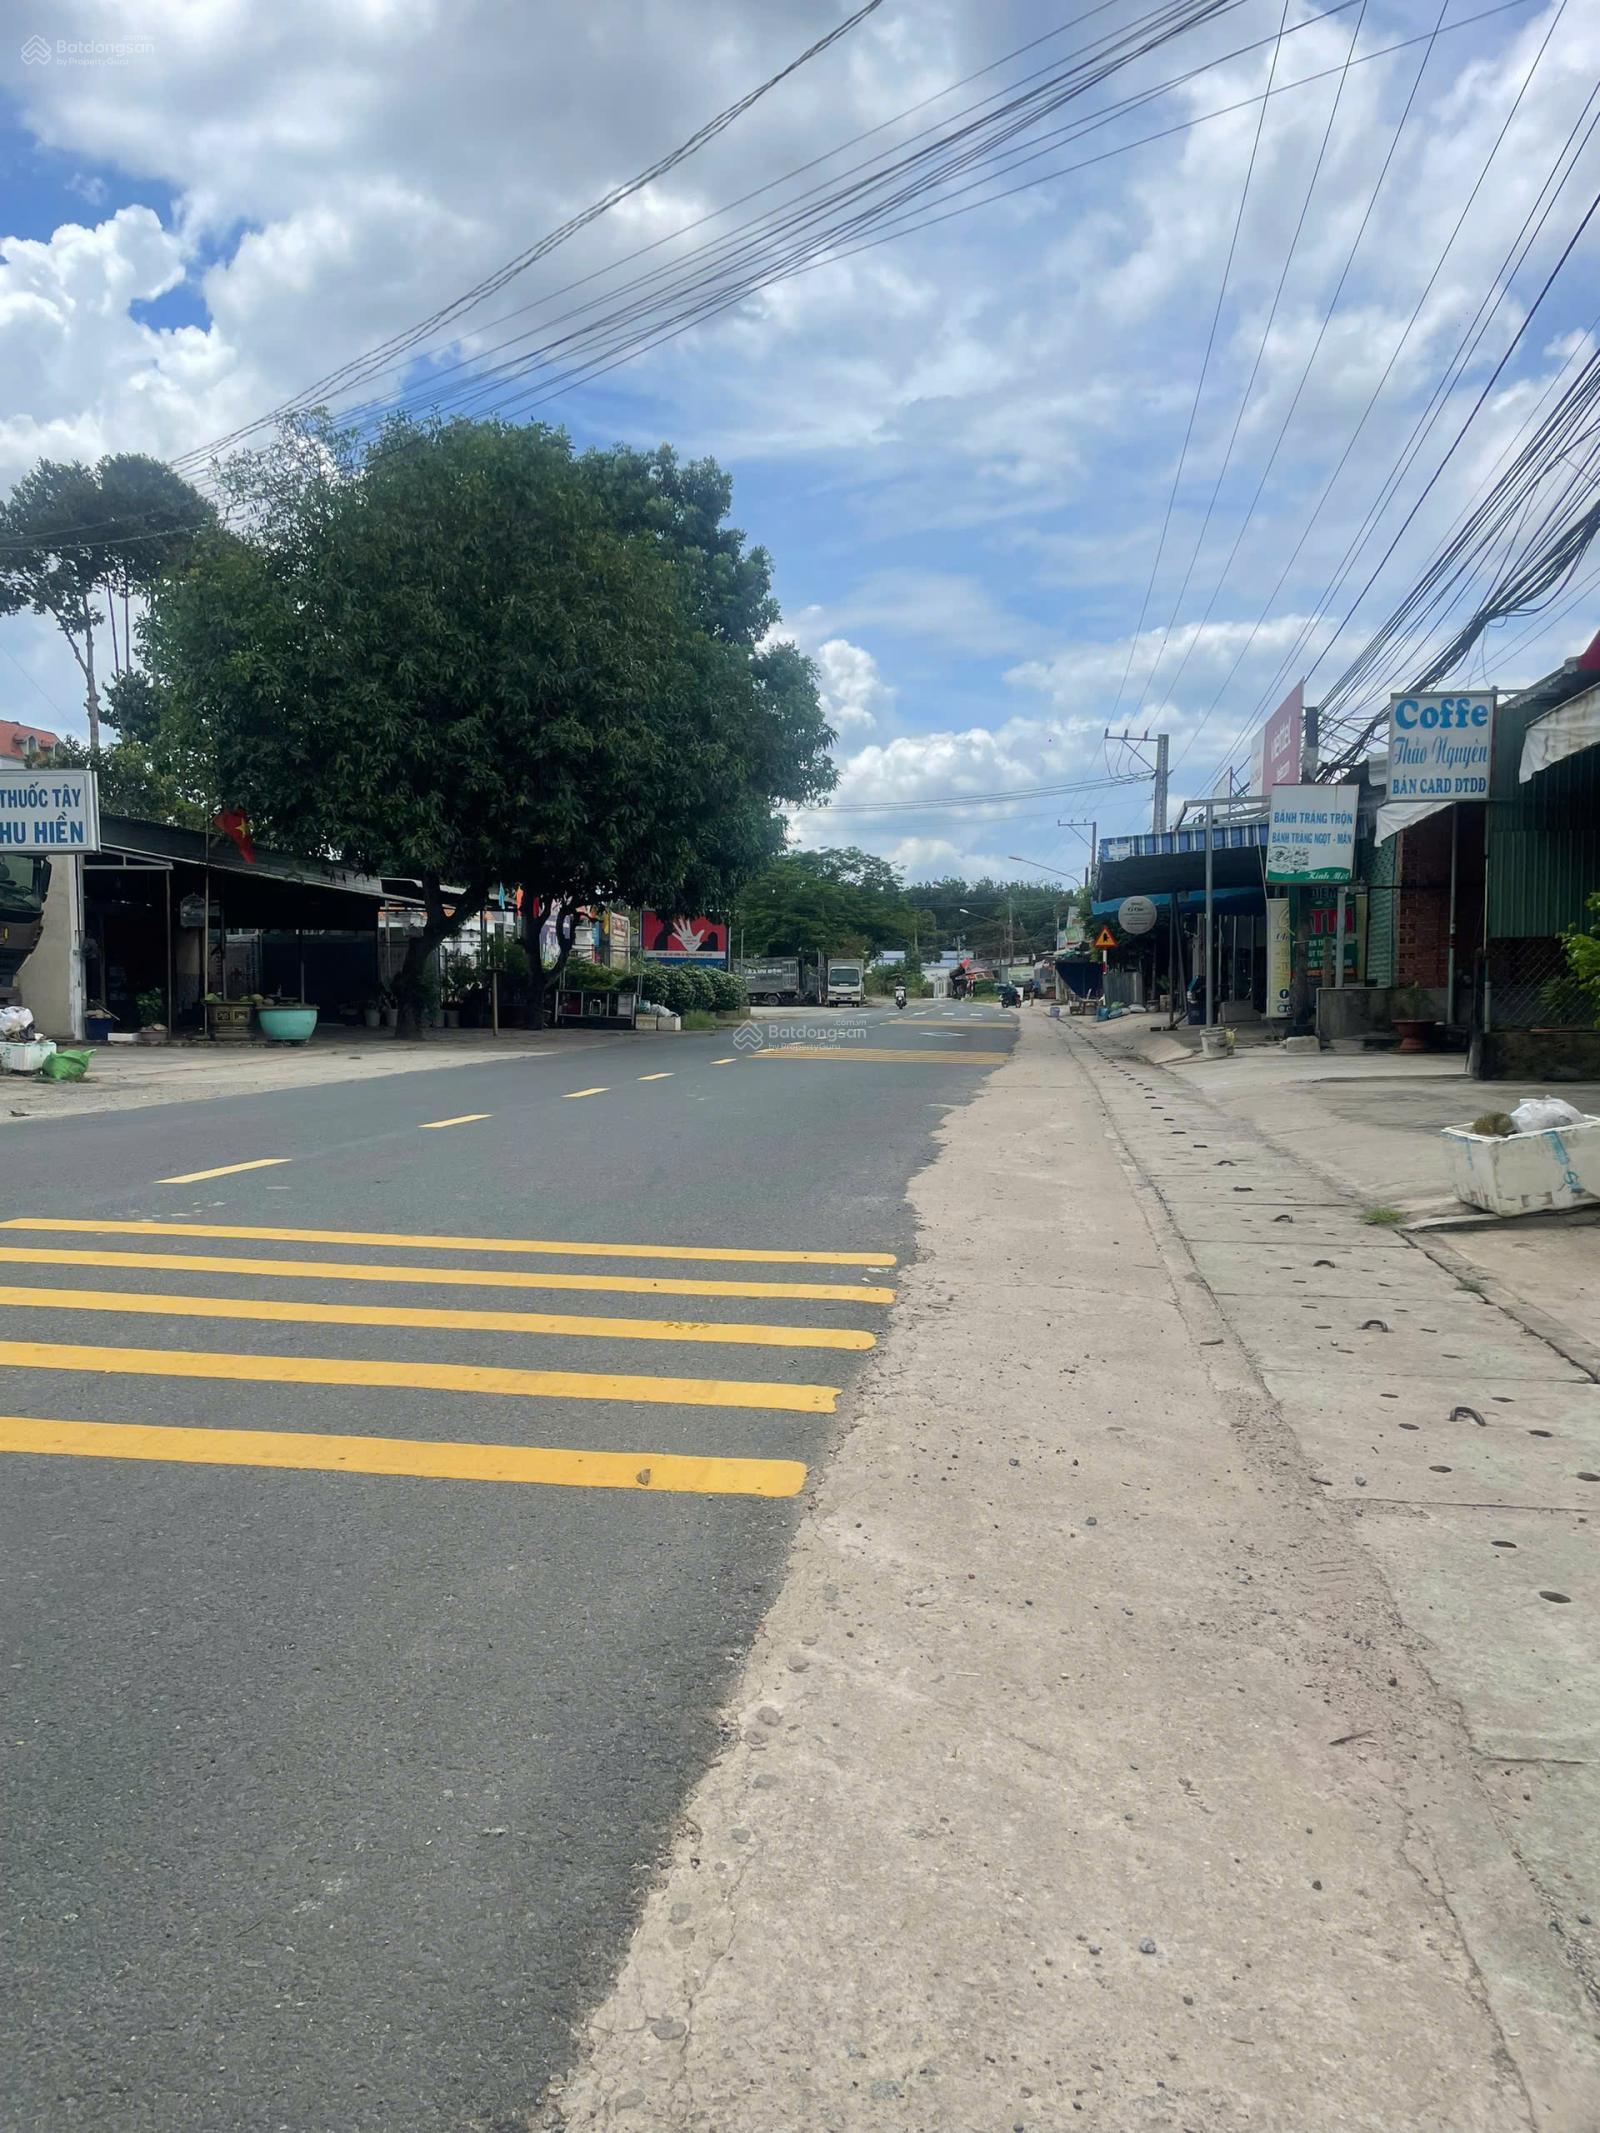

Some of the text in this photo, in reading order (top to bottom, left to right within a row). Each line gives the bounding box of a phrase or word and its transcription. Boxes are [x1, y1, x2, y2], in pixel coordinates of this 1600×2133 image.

[1395, 697, 1489, 730] Coffe
[0, 782, 81, 808] THUỐC TÂY
[1420, 777, 1452, 794] CARD
[34, 811, 84, 844] HIỀN
[1274, 809, 1353, 826] BÁNH TRÁNG TRỘN
[1272, 830, 1290, 843] BÁNH
[1291, 830, 1313, 844] TRÁNG
[1314, 832, 1331, 846] NGỌT
